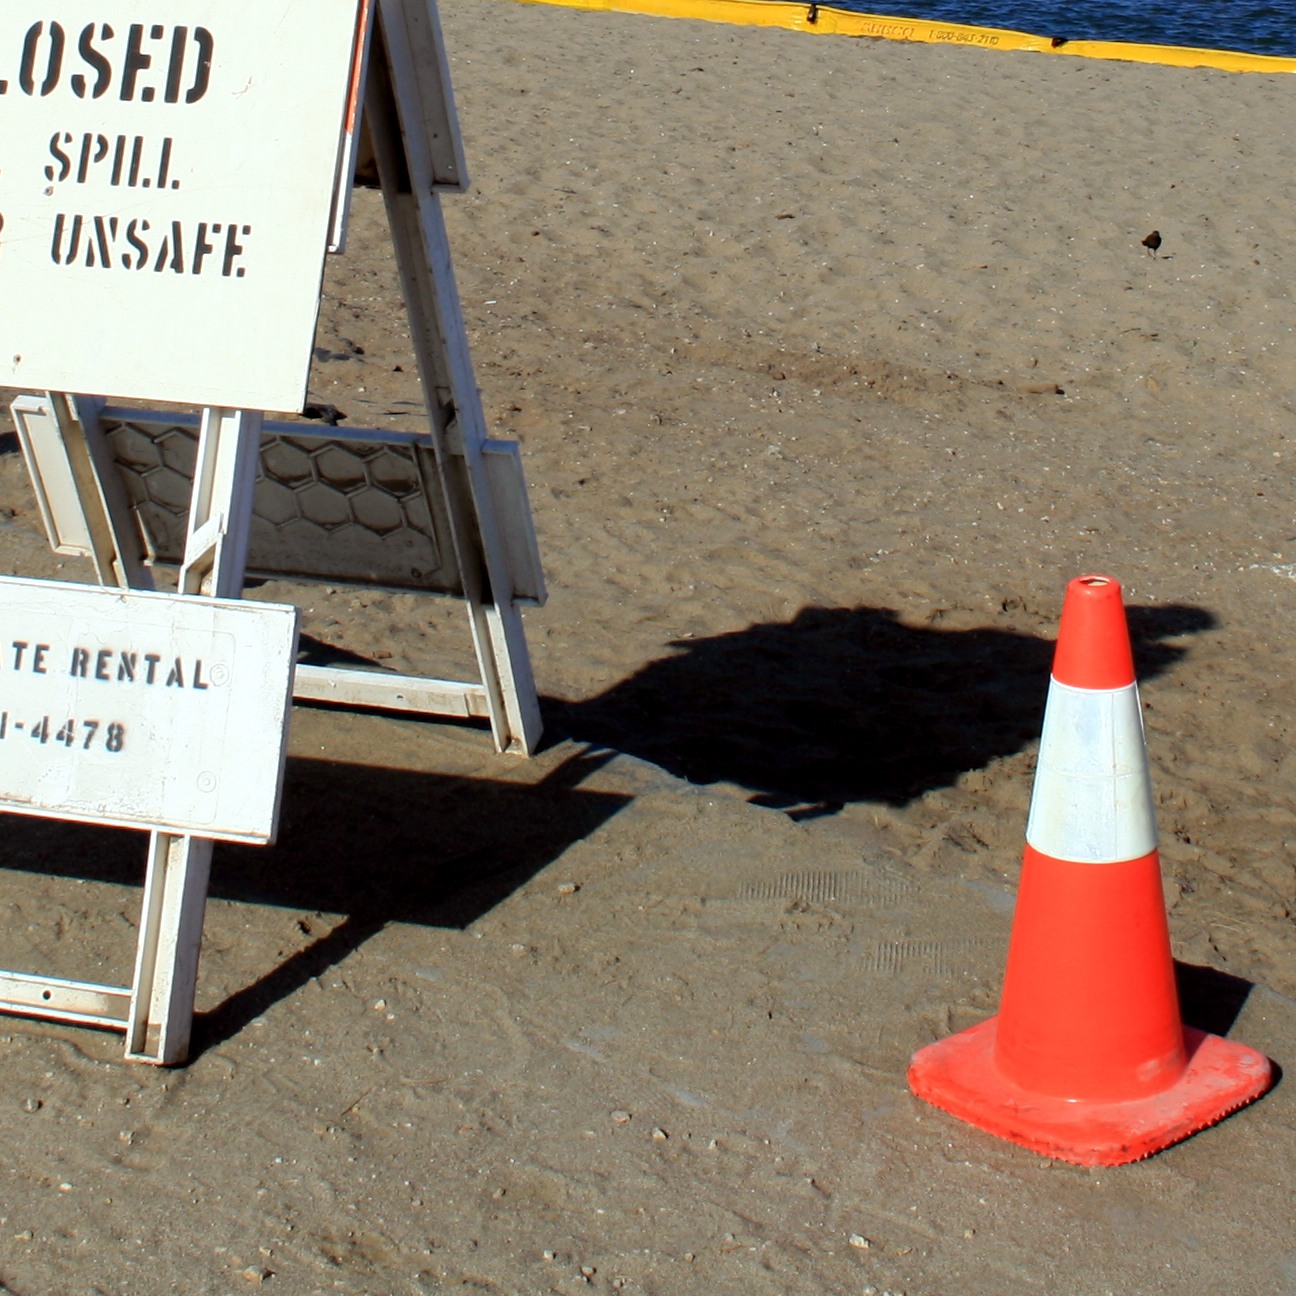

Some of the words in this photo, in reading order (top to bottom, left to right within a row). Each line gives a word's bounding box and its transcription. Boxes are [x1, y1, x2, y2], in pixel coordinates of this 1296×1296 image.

[44, 131, 180, 189] SPILL
[51, 213, 251, 278] UNSAFE
[70, 647, 209, 690] RENTAL
